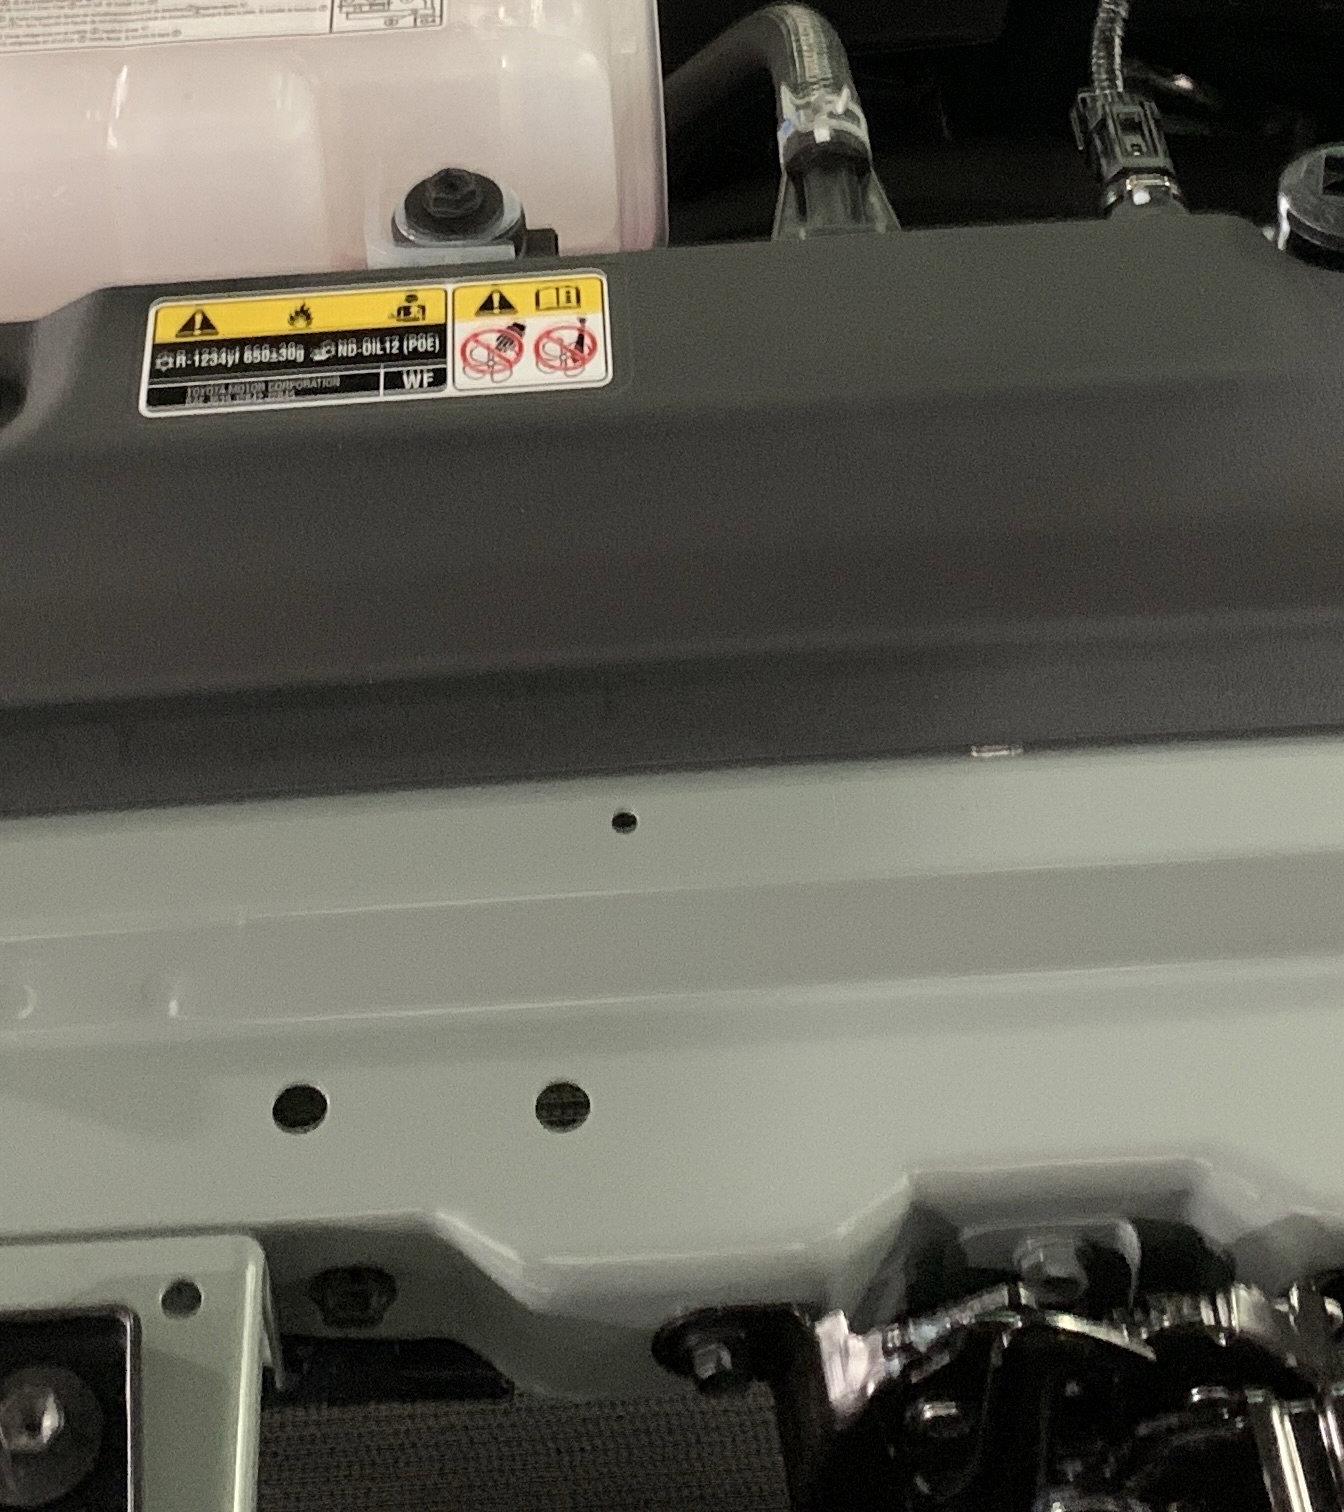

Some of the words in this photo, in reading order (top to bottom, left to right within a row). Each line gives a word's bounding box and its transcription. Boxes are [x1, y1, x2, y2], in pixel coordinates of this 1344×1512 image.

[337, 335, 400, 357] ND-OIL12
[403, 333, 440, 355] (POE)
[186, 385, 226, 397] TOYOTA
[228, 381, 265, 394] MOTOR
[267, 375, 340, 392] CORPORATION
[402, 368, 434, 389] WF
